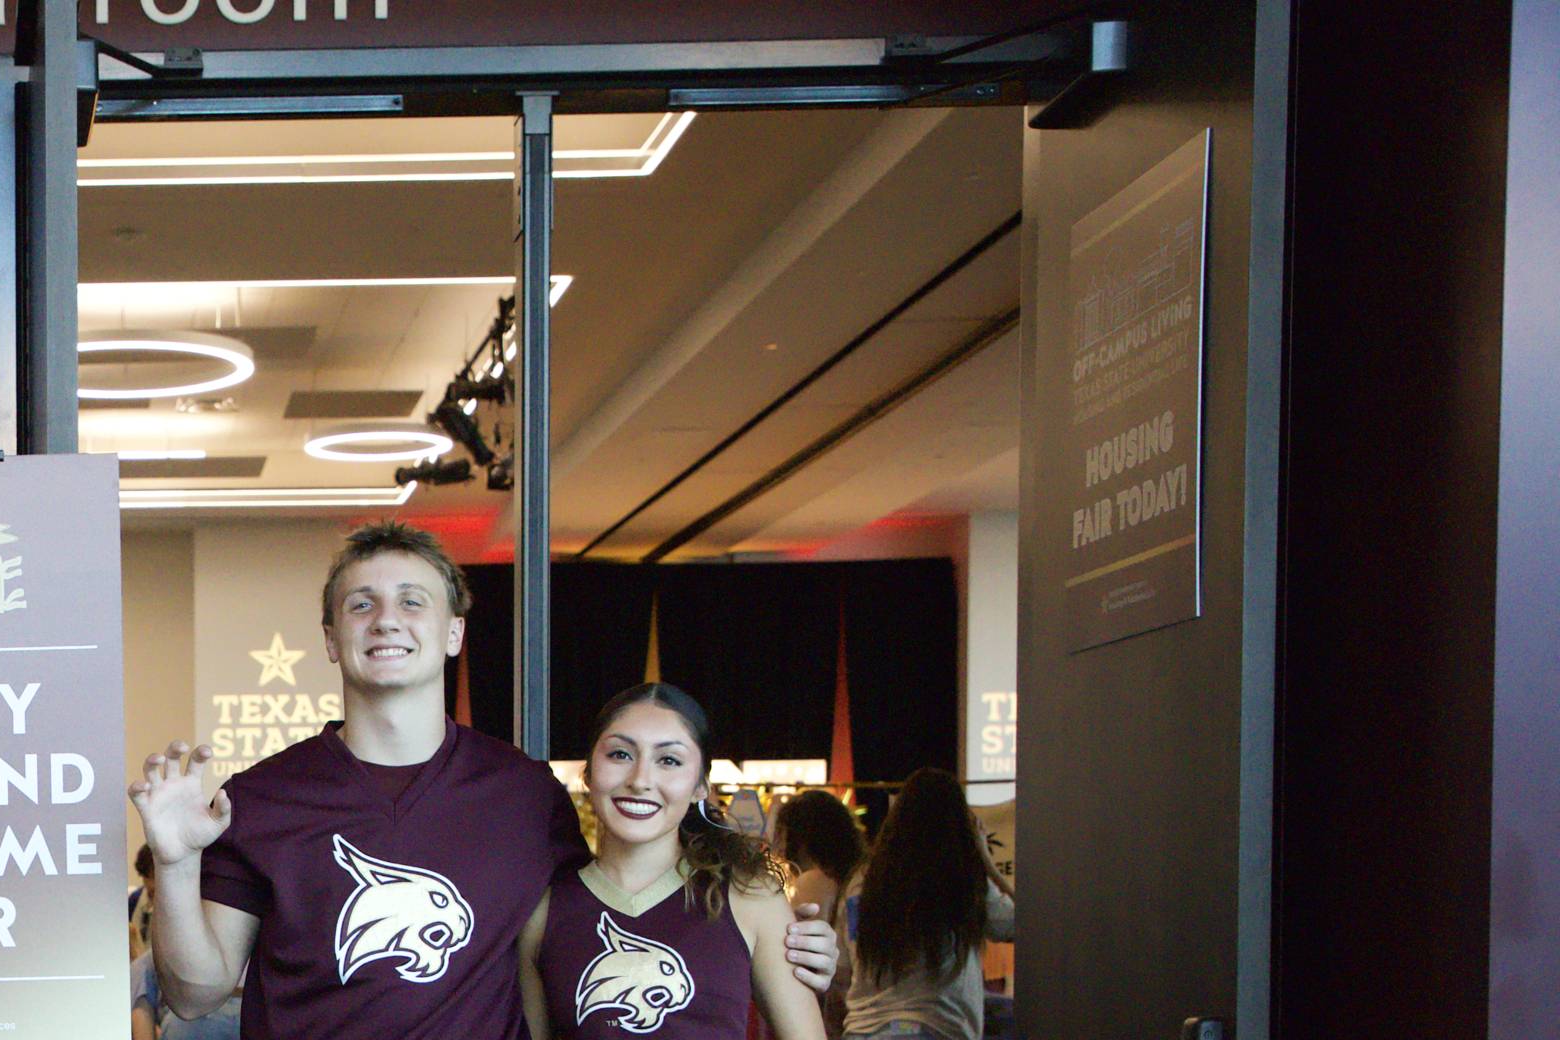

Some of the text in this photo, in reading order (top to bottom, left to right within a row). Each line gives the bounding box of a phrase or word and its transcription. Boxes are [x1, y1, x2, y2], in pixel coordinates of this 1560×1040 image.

[1151, 294, 1193, 339] LIVING
[1086, 409, 1175, 488] HOUSING
[1072, 463, 1188, 549] FAIR TODAY!
[212, 693, 341, 724] TEXAS
